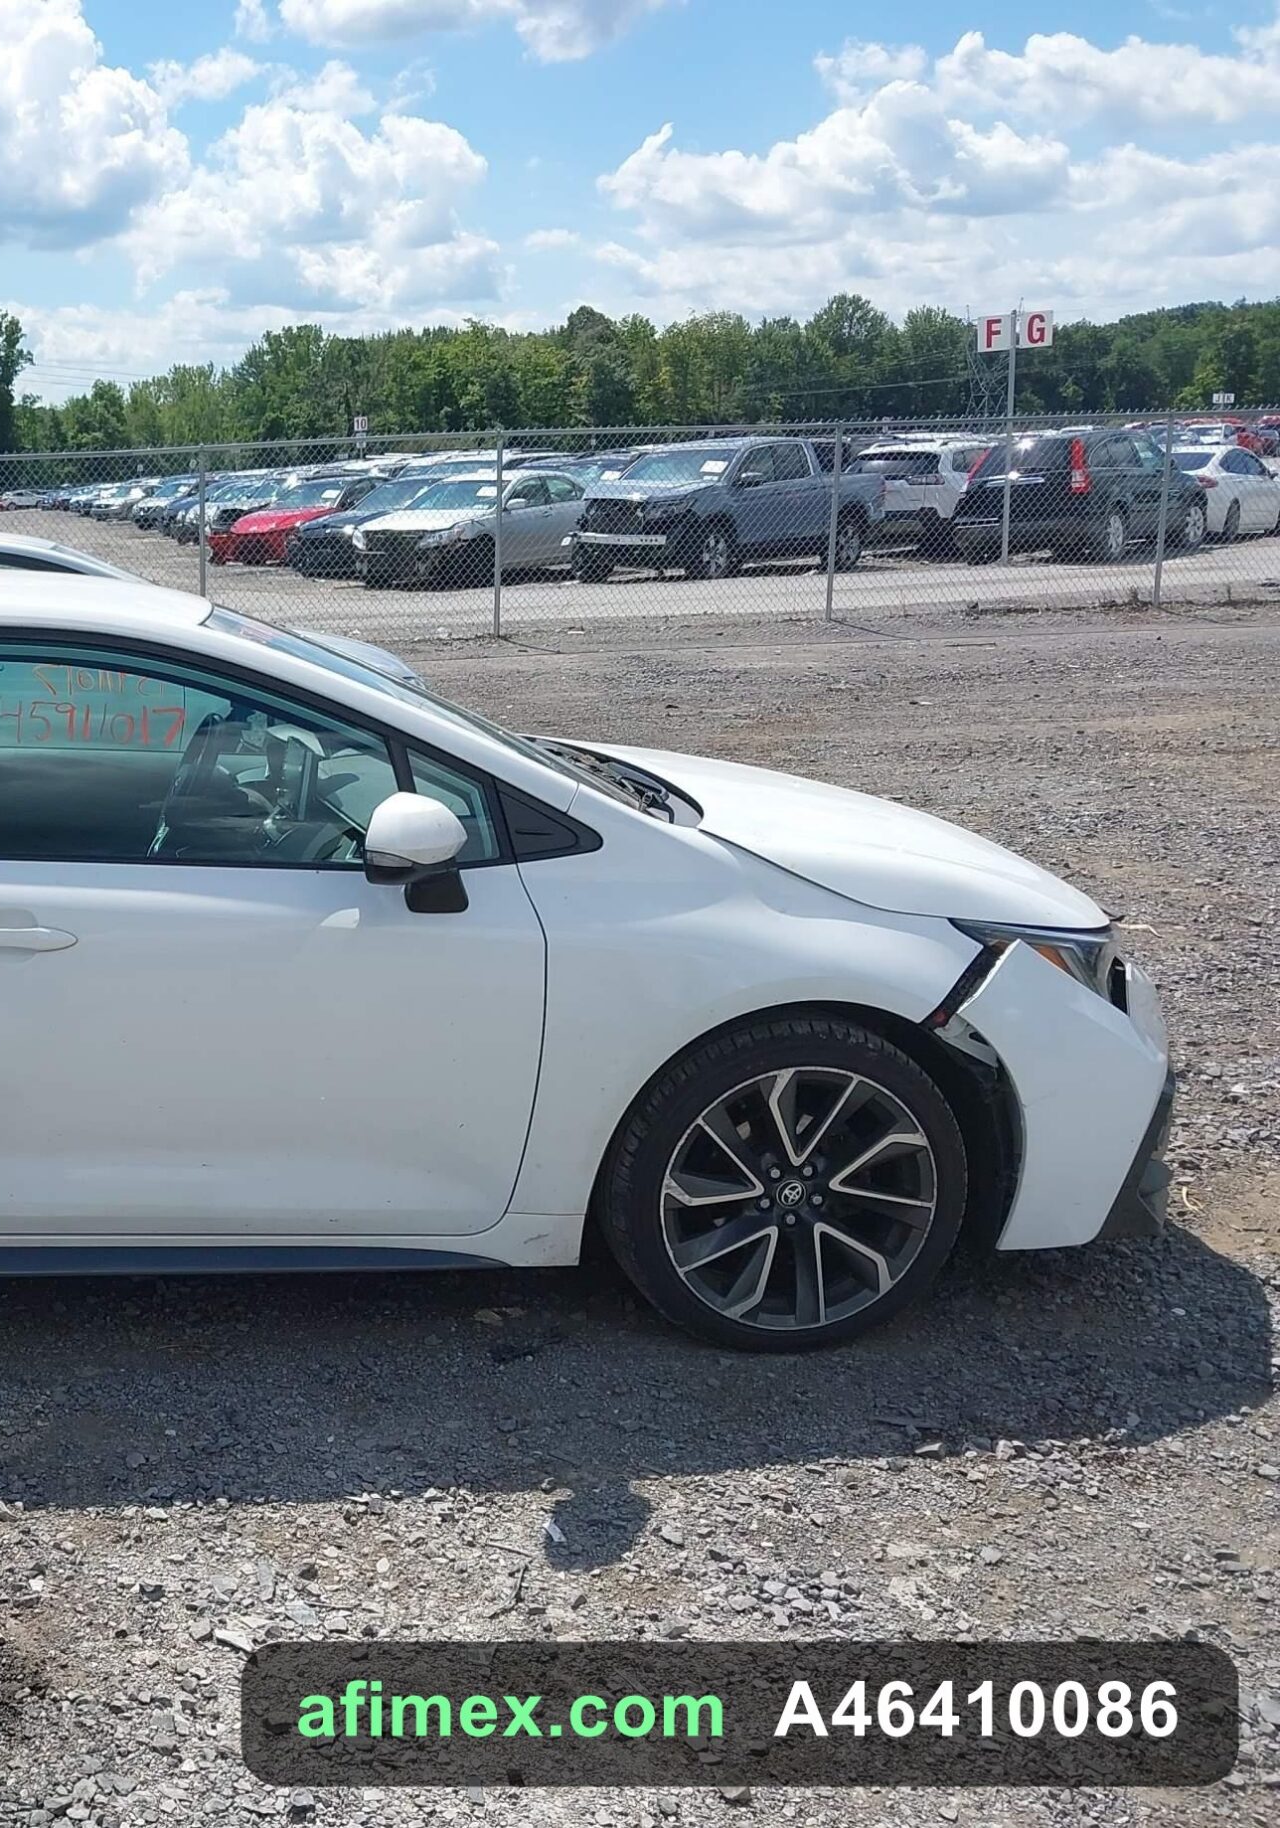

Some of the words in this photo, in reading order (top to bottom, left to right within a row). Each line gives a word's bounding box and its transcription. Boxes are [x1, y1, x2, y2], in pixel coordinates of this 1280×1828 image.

[986, 319, 1002, 348] F
[1028, 314, 1046, 344] G
[355, 418, 368, 429] 10
